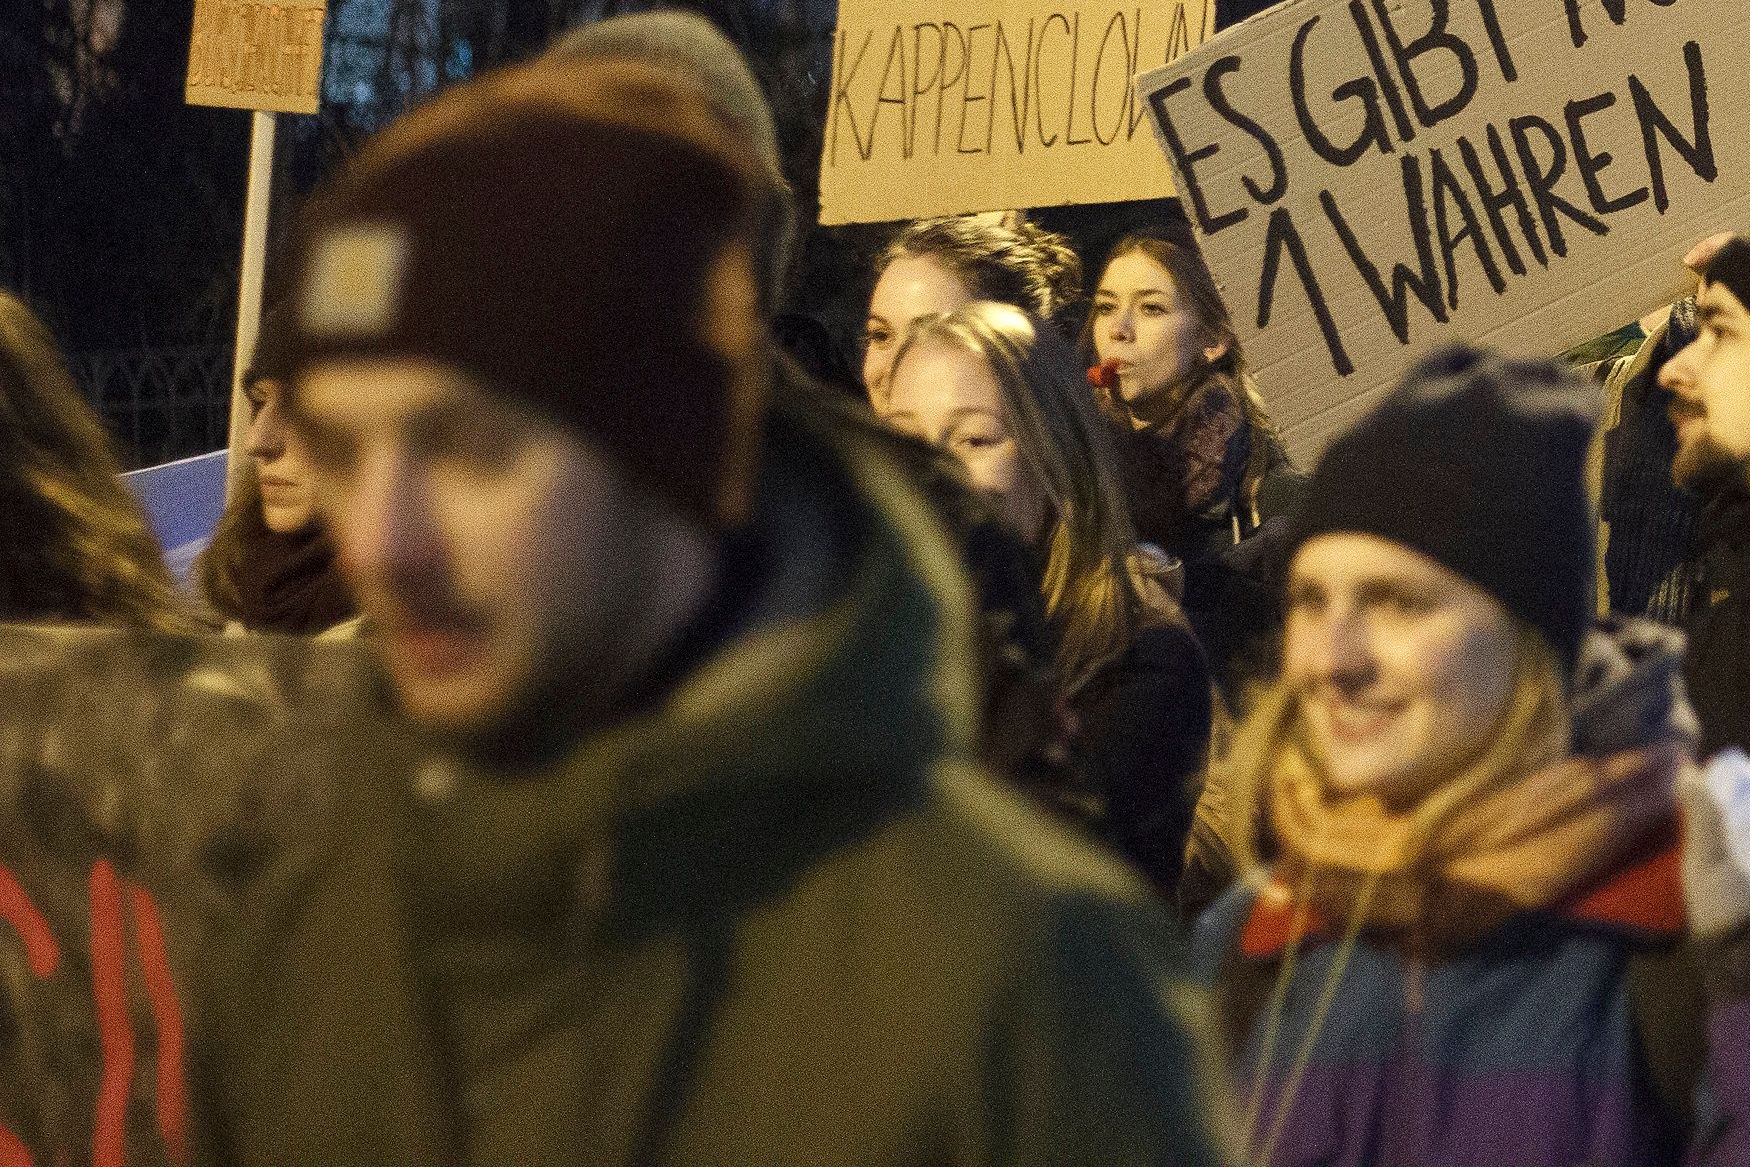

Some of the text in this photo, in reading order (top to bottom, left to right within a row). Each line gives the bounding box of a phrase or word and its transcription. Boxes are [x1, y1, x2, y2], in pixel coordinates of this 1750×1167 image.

[1146, 53, 1288, 236] ES
[1255, 39, 1719, 377] 1 WAHREN
